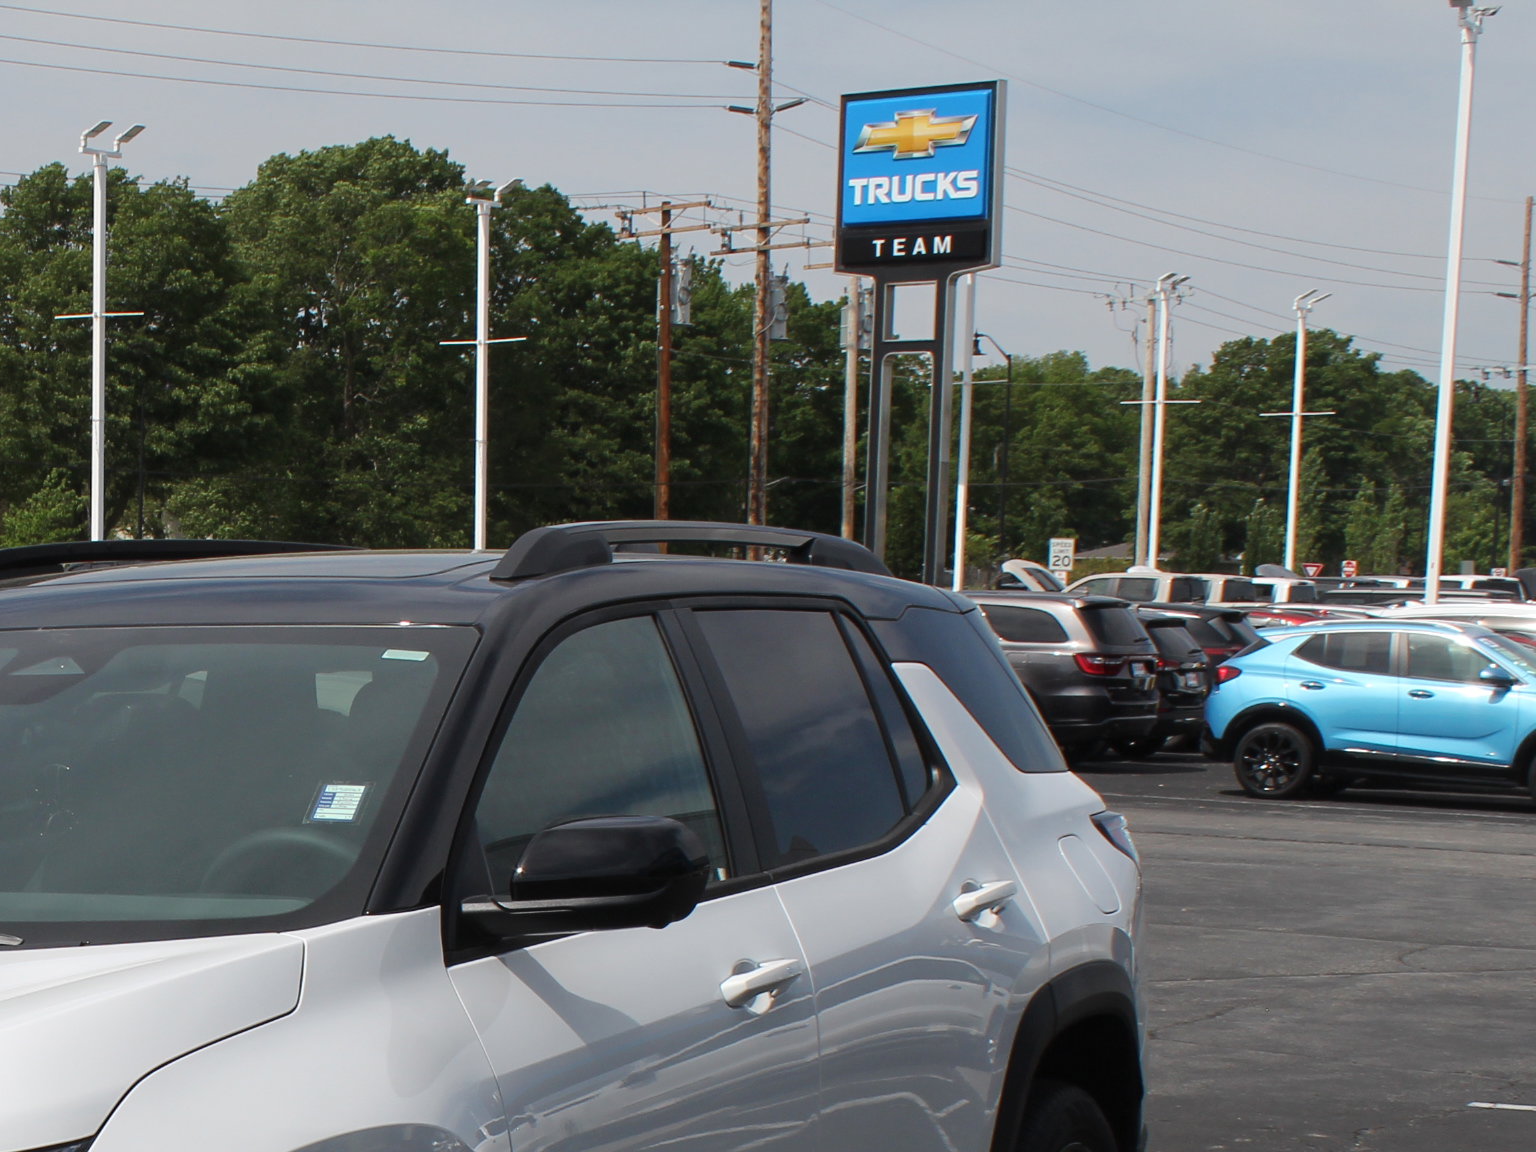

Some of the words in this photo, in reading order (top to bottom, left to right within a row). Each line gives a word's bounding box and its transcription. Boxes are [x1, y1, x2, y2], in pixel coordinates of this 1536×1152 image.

[849, 170, 979, 205] TRUCKS
[872, 235, 952, 257] TEAM
[1052, 555, 1071, 567] 20
